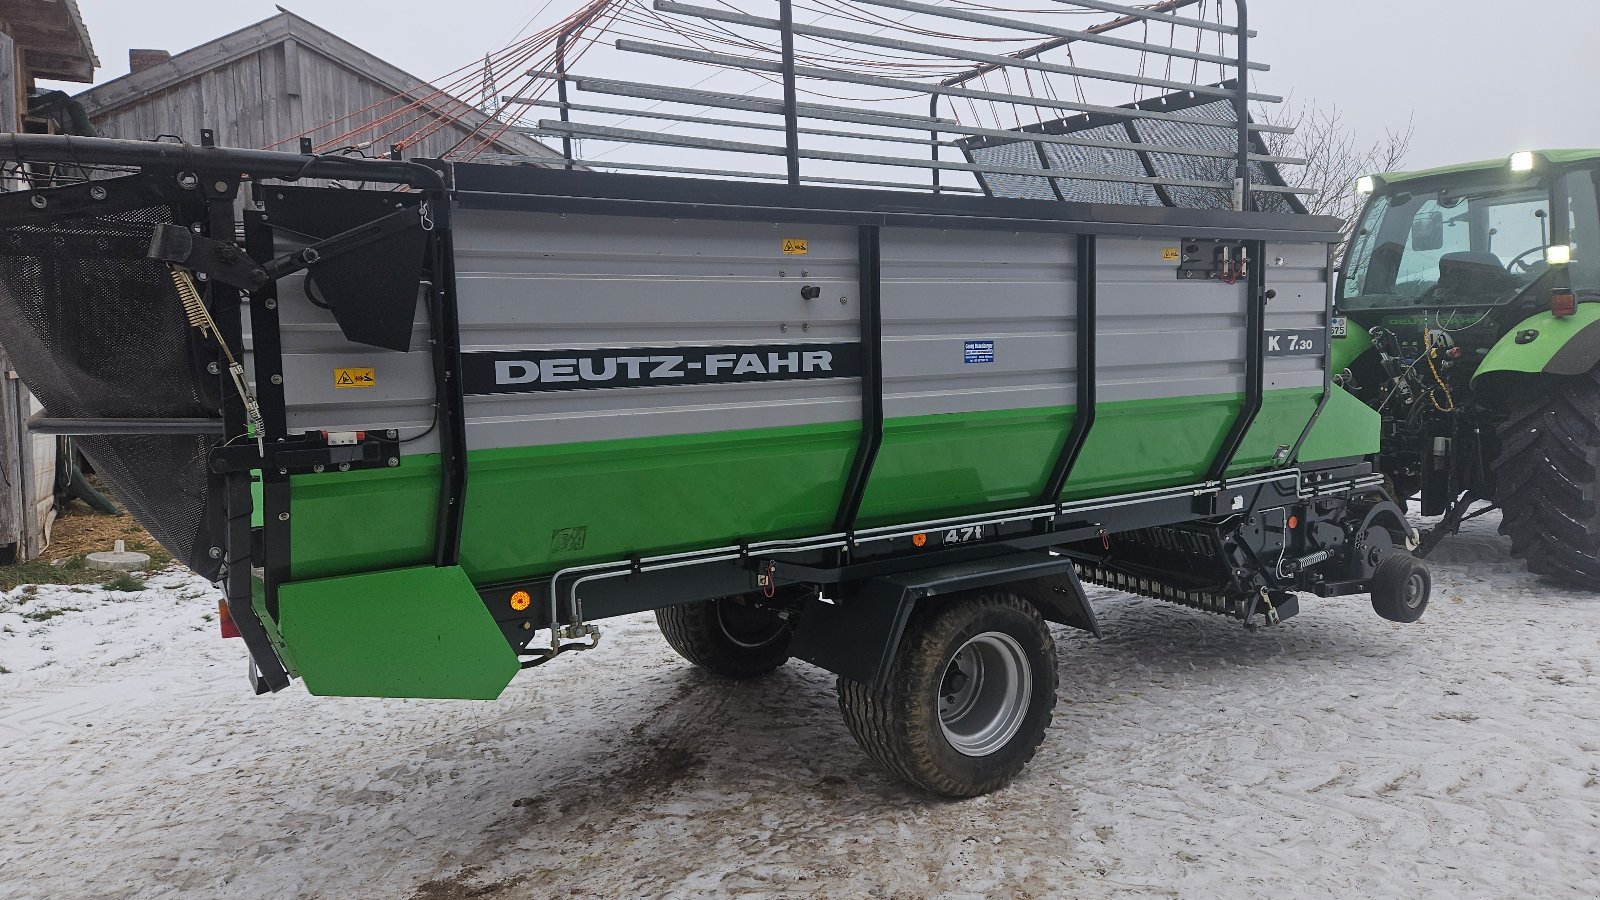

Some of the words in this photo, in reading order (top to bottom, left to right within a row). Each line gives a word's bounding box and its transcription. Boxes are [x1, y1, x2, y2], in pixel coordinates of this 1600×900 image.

[1268, 335, 1281, 351] K
[1287, 334, 1313, 351] 7.30
[494, 350, 833, 385] DEUTZ-FAHR
[945, 525, 982, 543] 4.7t
